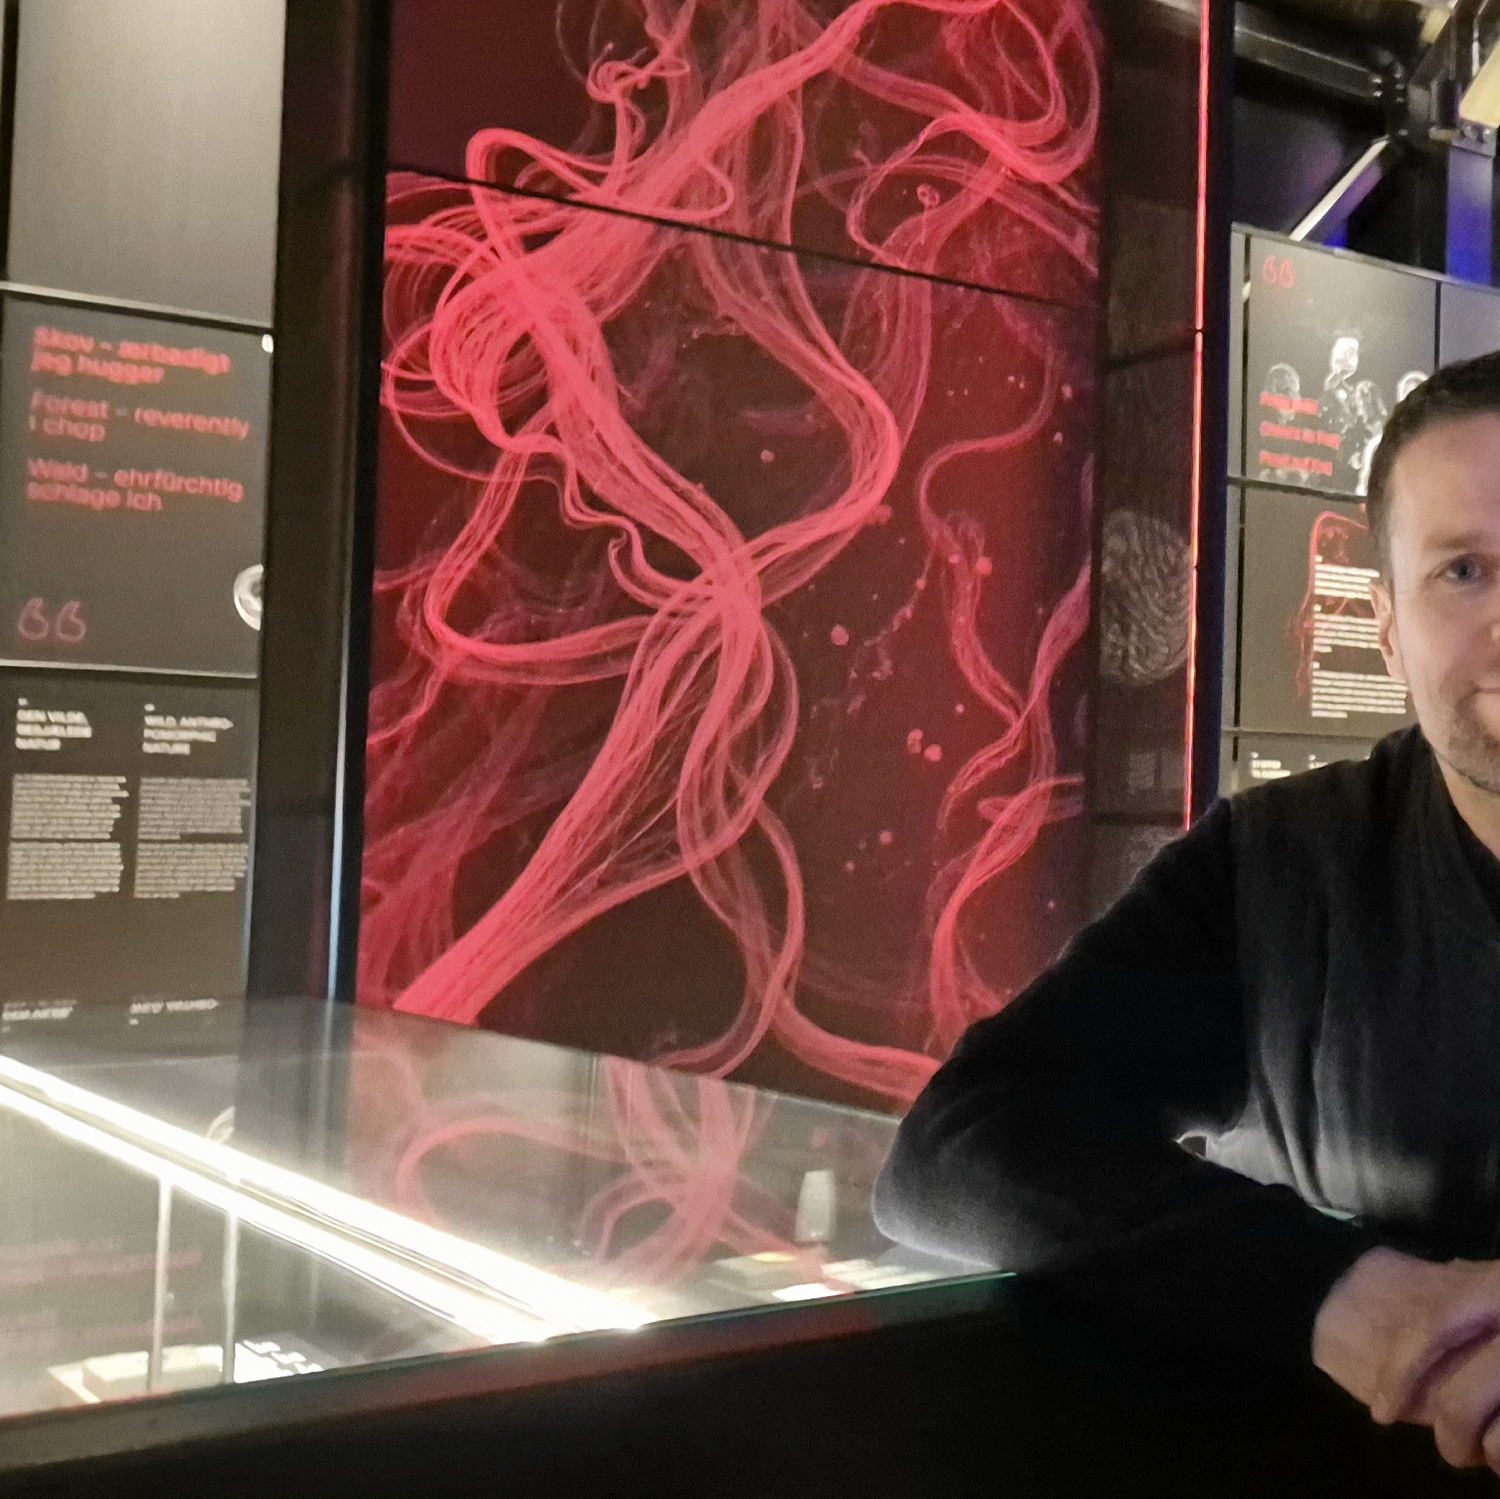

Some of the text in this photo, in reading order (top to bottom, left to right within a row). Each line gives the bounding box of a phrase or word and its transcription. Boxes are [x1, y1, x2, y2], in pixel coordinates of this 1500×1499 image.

[31, 391, 109, 419] Forest
[134, 407, 250, 440] reverently
[43, 417, 106, 442] chop
[114, 468, 244, 503] ehrfürchtig
[126, 490, 163, 511] ich
